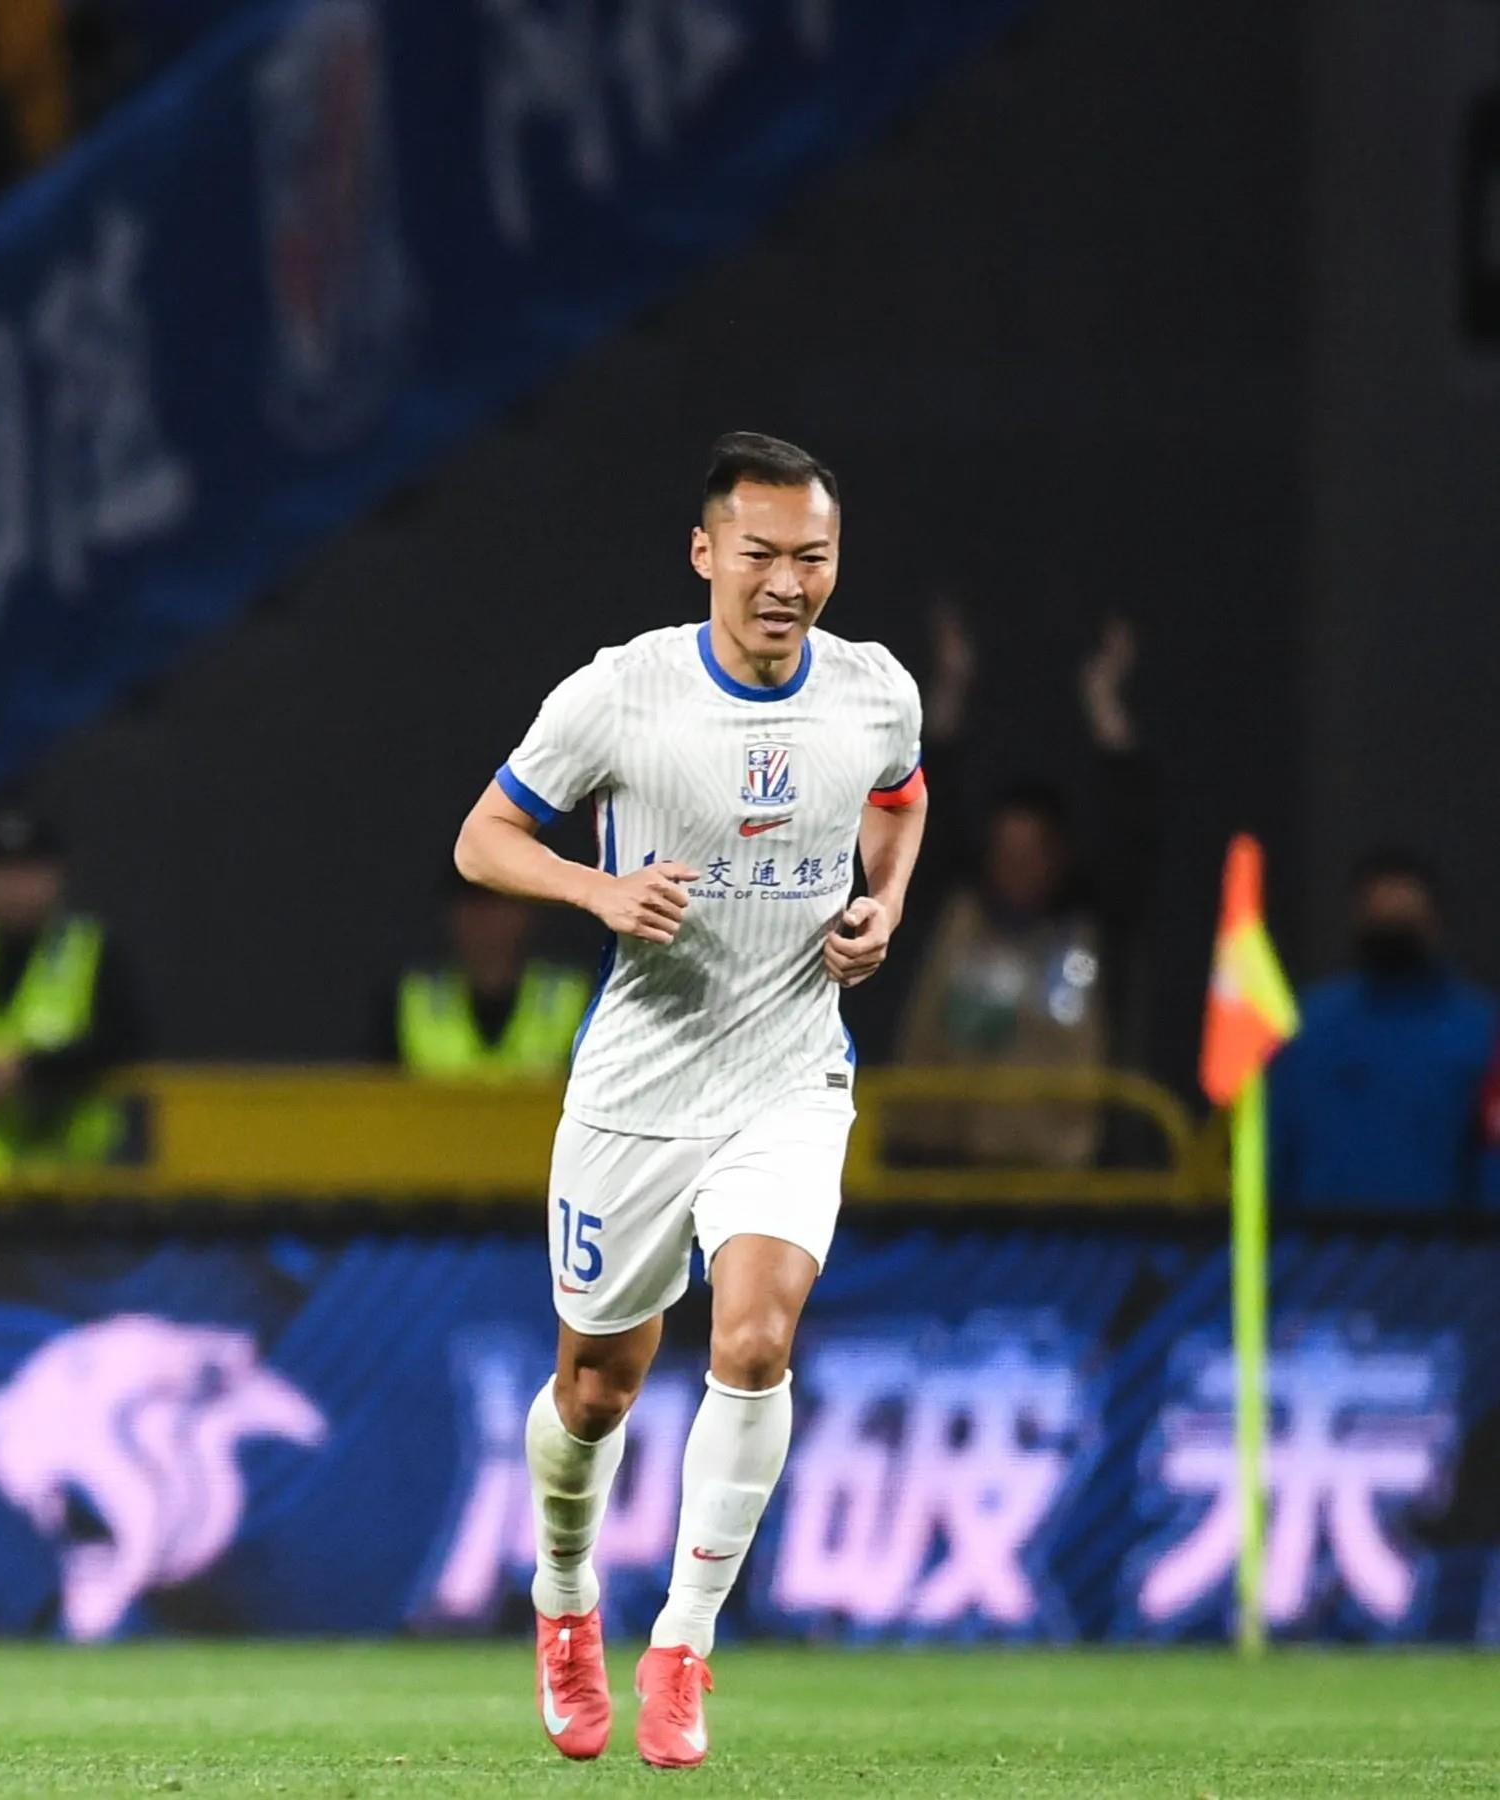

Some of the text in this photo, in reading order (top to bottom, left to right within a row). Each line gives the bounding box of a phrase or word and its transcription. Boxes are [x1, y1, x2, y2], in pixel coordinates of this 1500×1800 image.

[705, 851, 849, 887] 交通銀行
[687, 888, 727, 900] BANK
[733, 890, 753, 900] OF
[558, 1198, 603, 1282] 15
